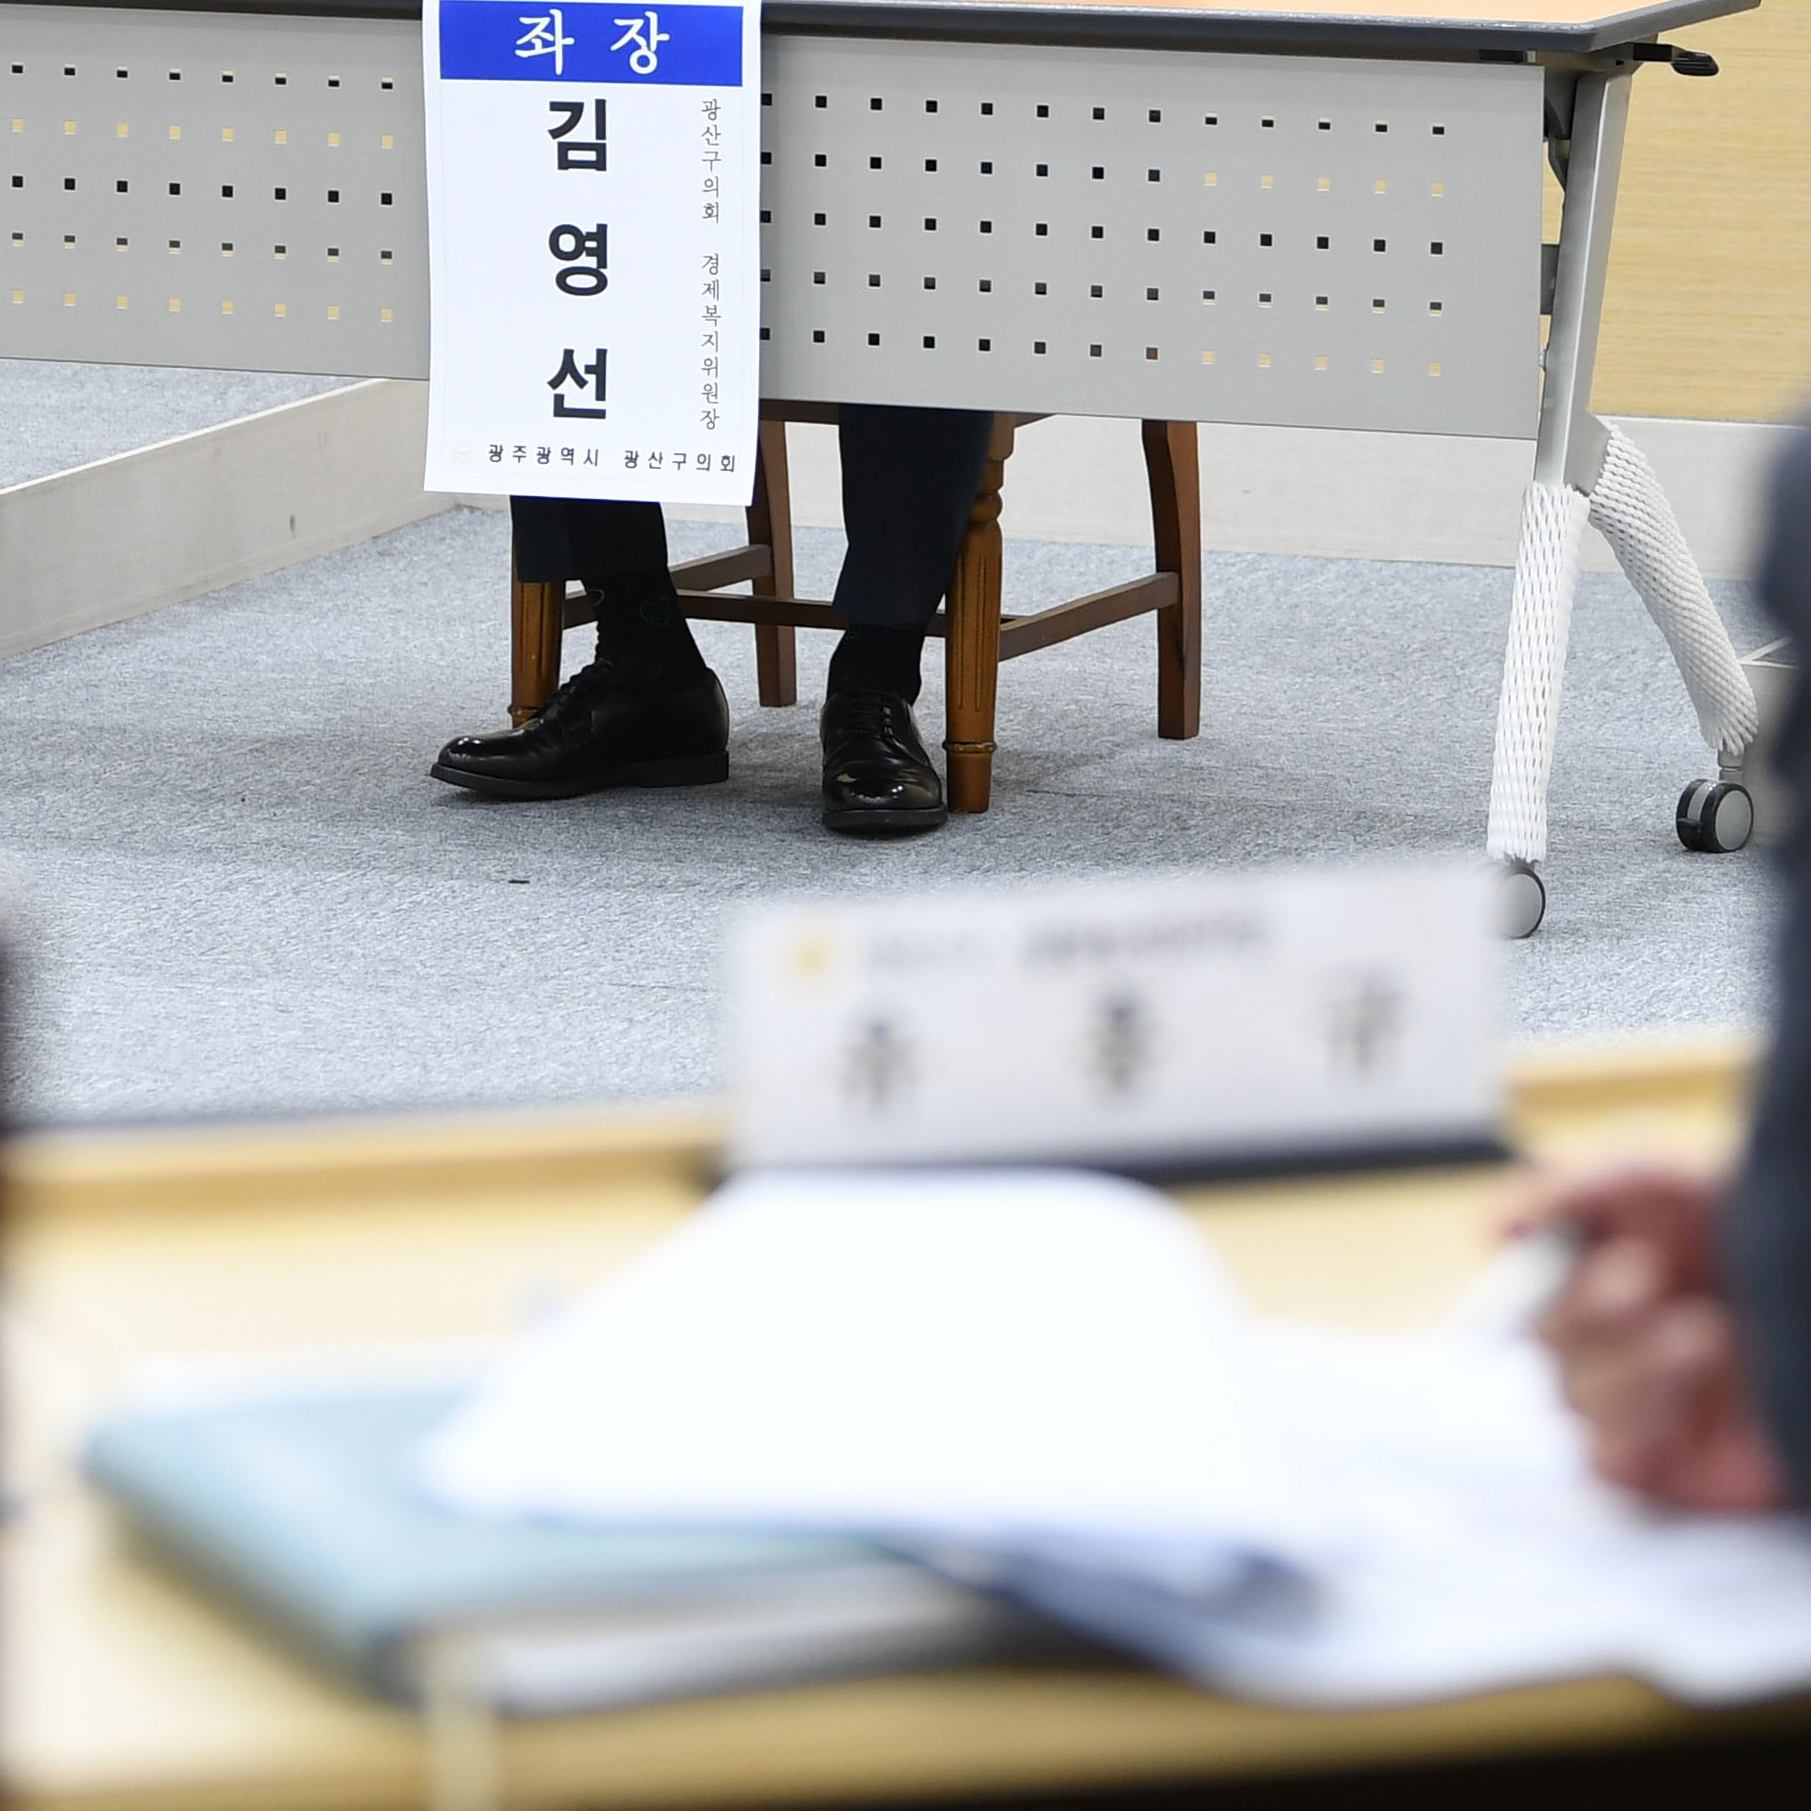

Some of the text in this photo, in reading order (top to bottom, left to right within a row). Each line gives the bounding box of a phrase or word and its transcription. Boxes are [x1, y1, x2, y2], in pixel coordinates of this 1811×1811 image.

[701, 99, 721, 430] 광산구의회 경제복지위원장
[489, 445, 734, 472] 광주광역시 광산구의회
